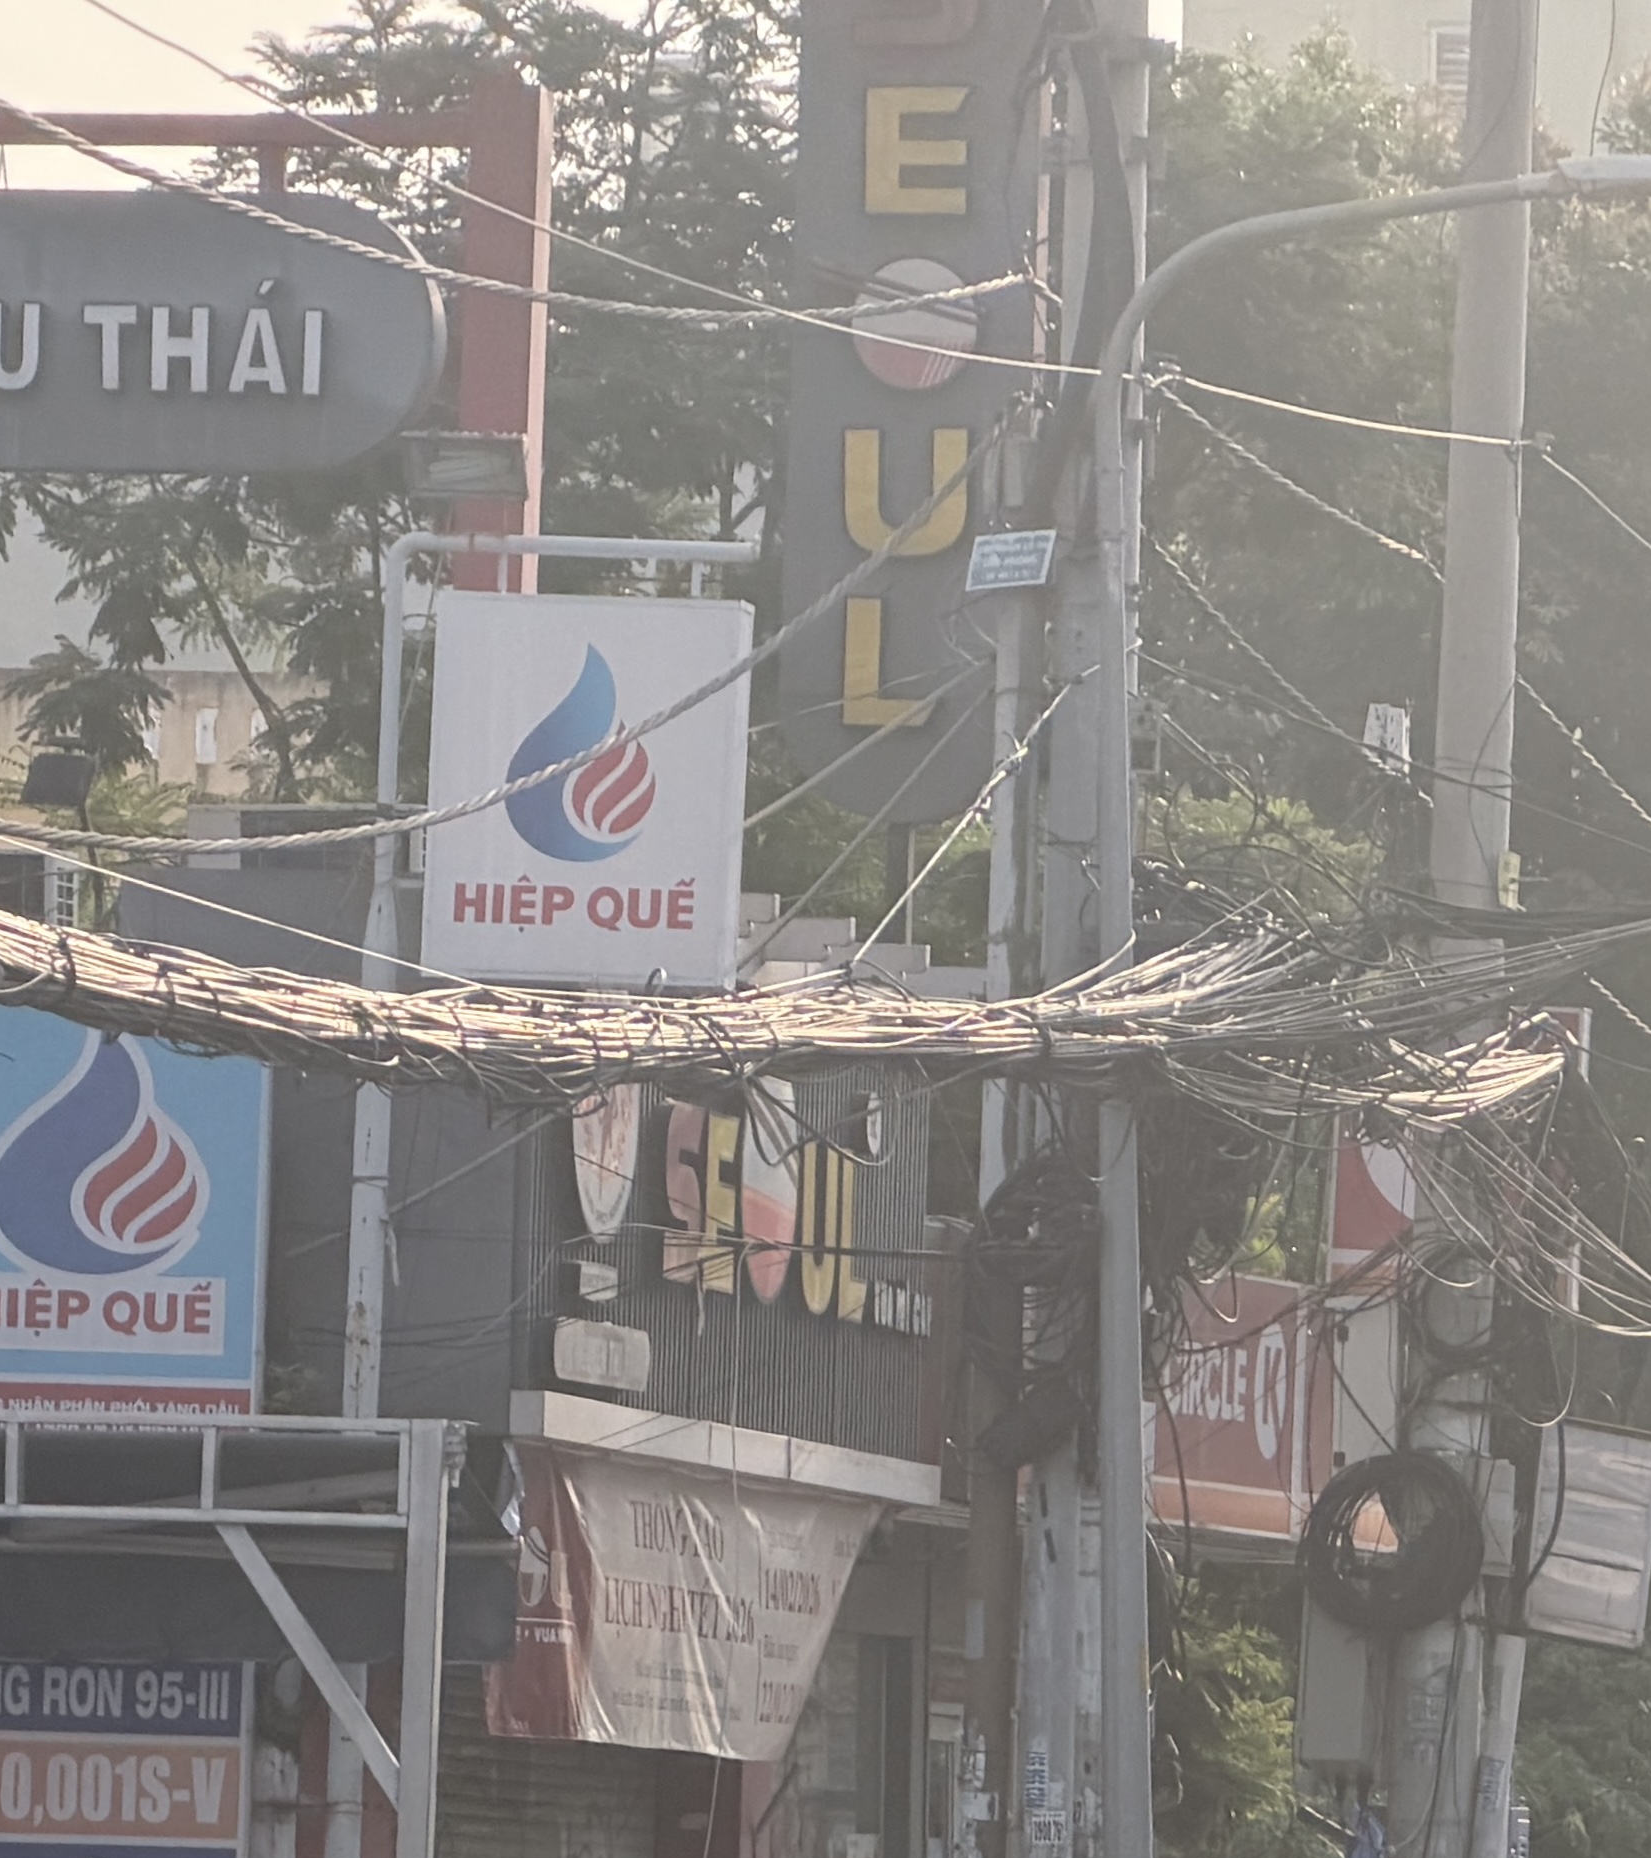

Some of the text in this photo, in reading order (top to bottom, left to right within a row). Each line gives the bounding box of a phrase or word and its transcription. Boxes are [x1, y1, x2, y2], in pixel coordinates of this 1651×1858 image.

[83, 279, 323, 396] THÁI
[843, 0, 979, 726] EOUL
[452, 875, 695, 933] HIỆP QUẾ
[102, 1281, 212, 1336] QUẾ
[43, 1665, 123, 1718] RON
[135, 1669, 230, 1721] 95-III
